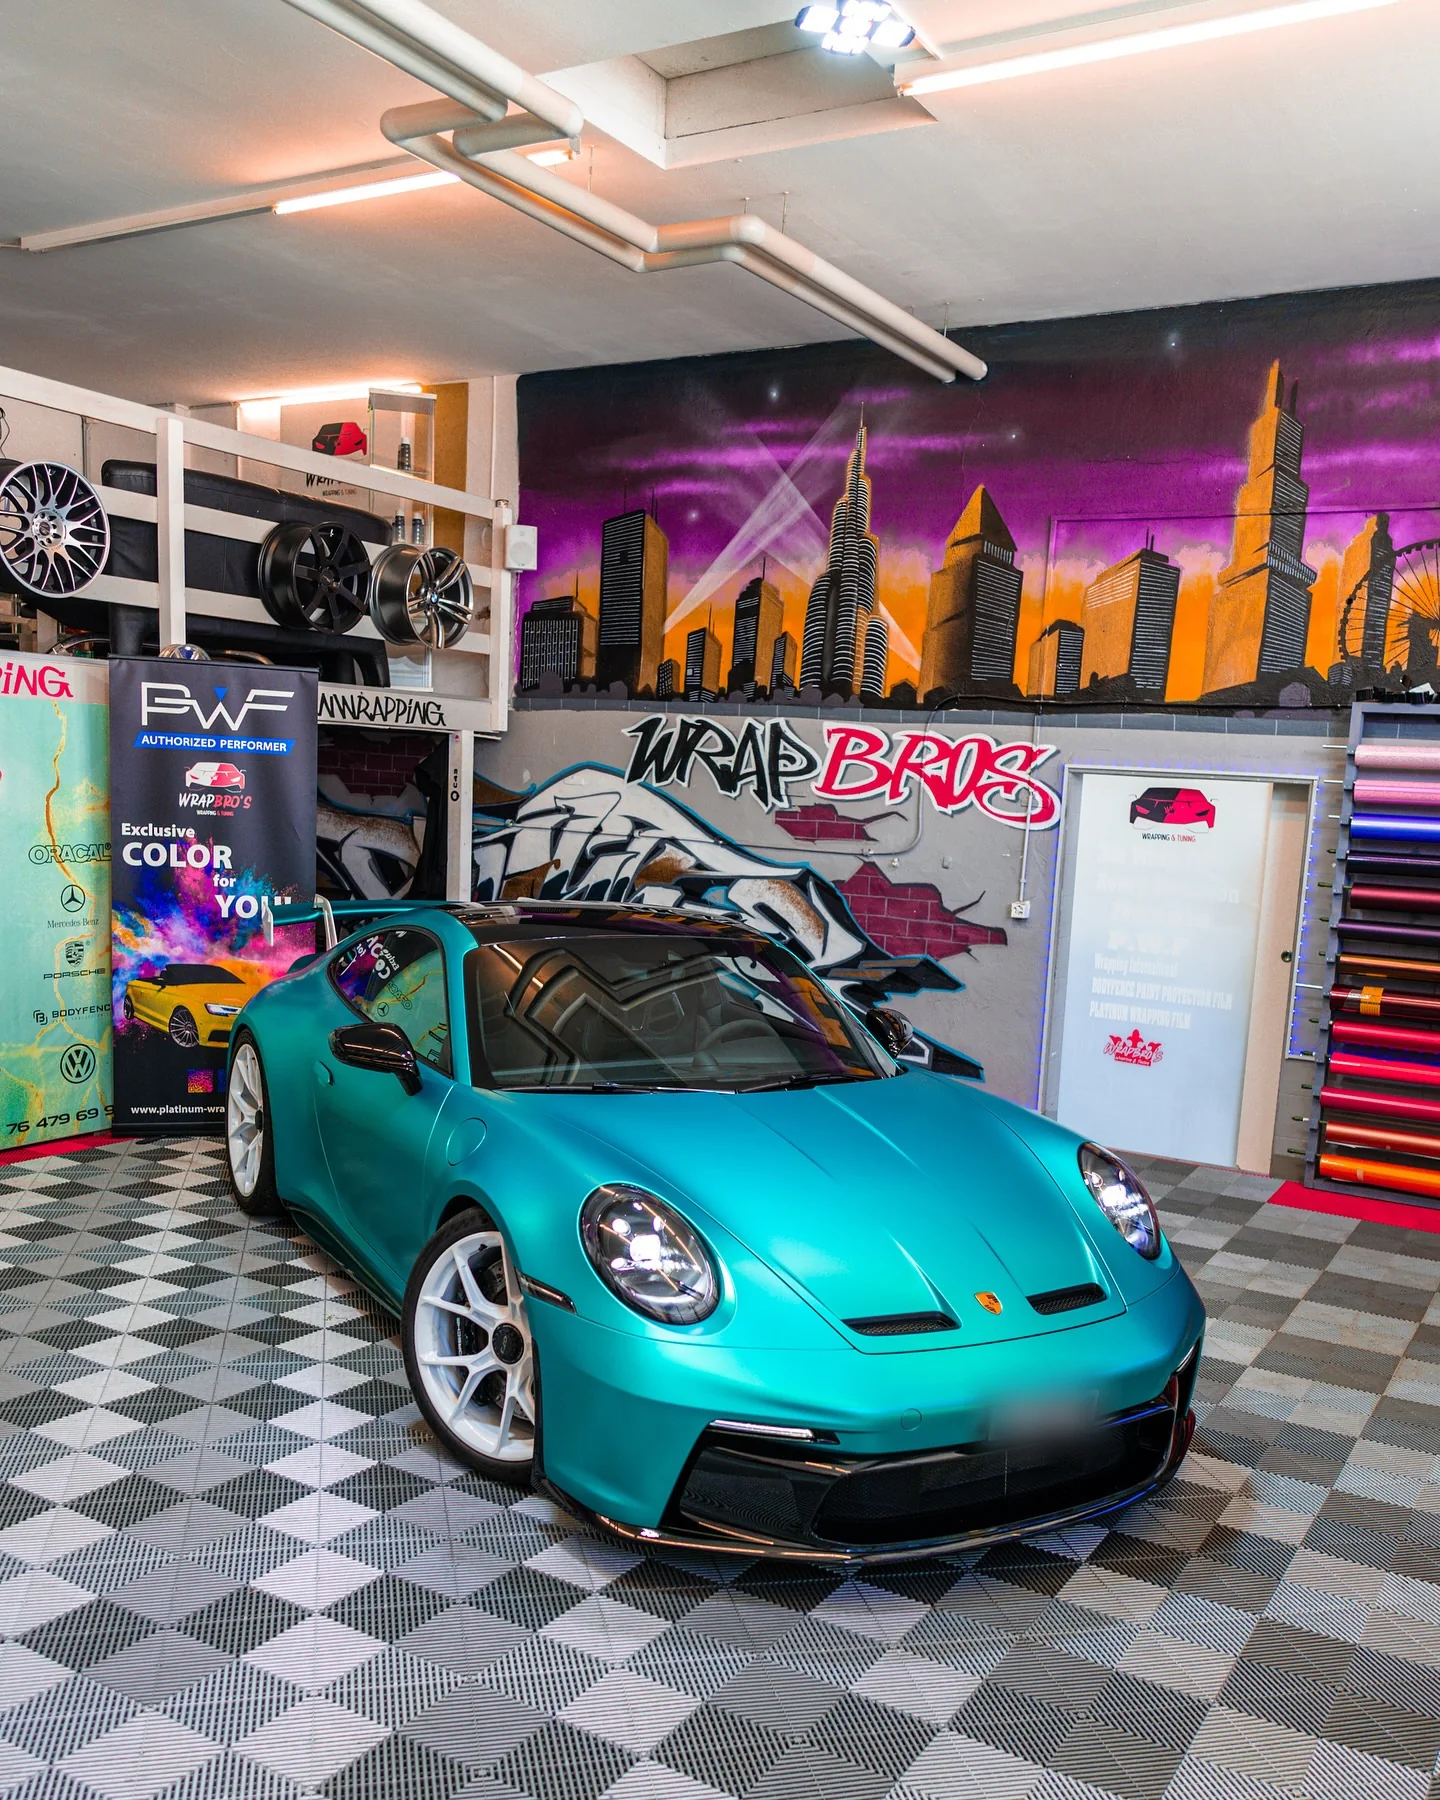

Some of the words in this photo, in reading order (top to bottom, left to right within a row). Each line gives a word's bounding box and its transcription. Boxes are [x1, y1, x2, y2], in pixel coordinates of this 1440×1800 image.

[141, 681, 295, 731] PWF
[141, 735, 216, 748] AUTHORIZED
[220, 739, 287, 752] PERFORMER
[622, 713, 821, 814] WRAP
[812, 721, 1062, 831] BROS
[178, 792, 252, 809] WRAPBRO'S
[121, 823, 195, 839] Exclusive
[1142, 832, 1170, 842] WRAPPING
[1171, 834, 1176, 842] &
[1177, 834, 1196, 843] TUNING
[122, 841, 233, 870] COLOR
[213, 874, 236, 888] for
[43, 967, 106, 981] PORSCHE
[6, 1120, 31, 1135] 76
[36, 1113, 71, 1129] 479
[75, 1107, 99, 1121] 69
